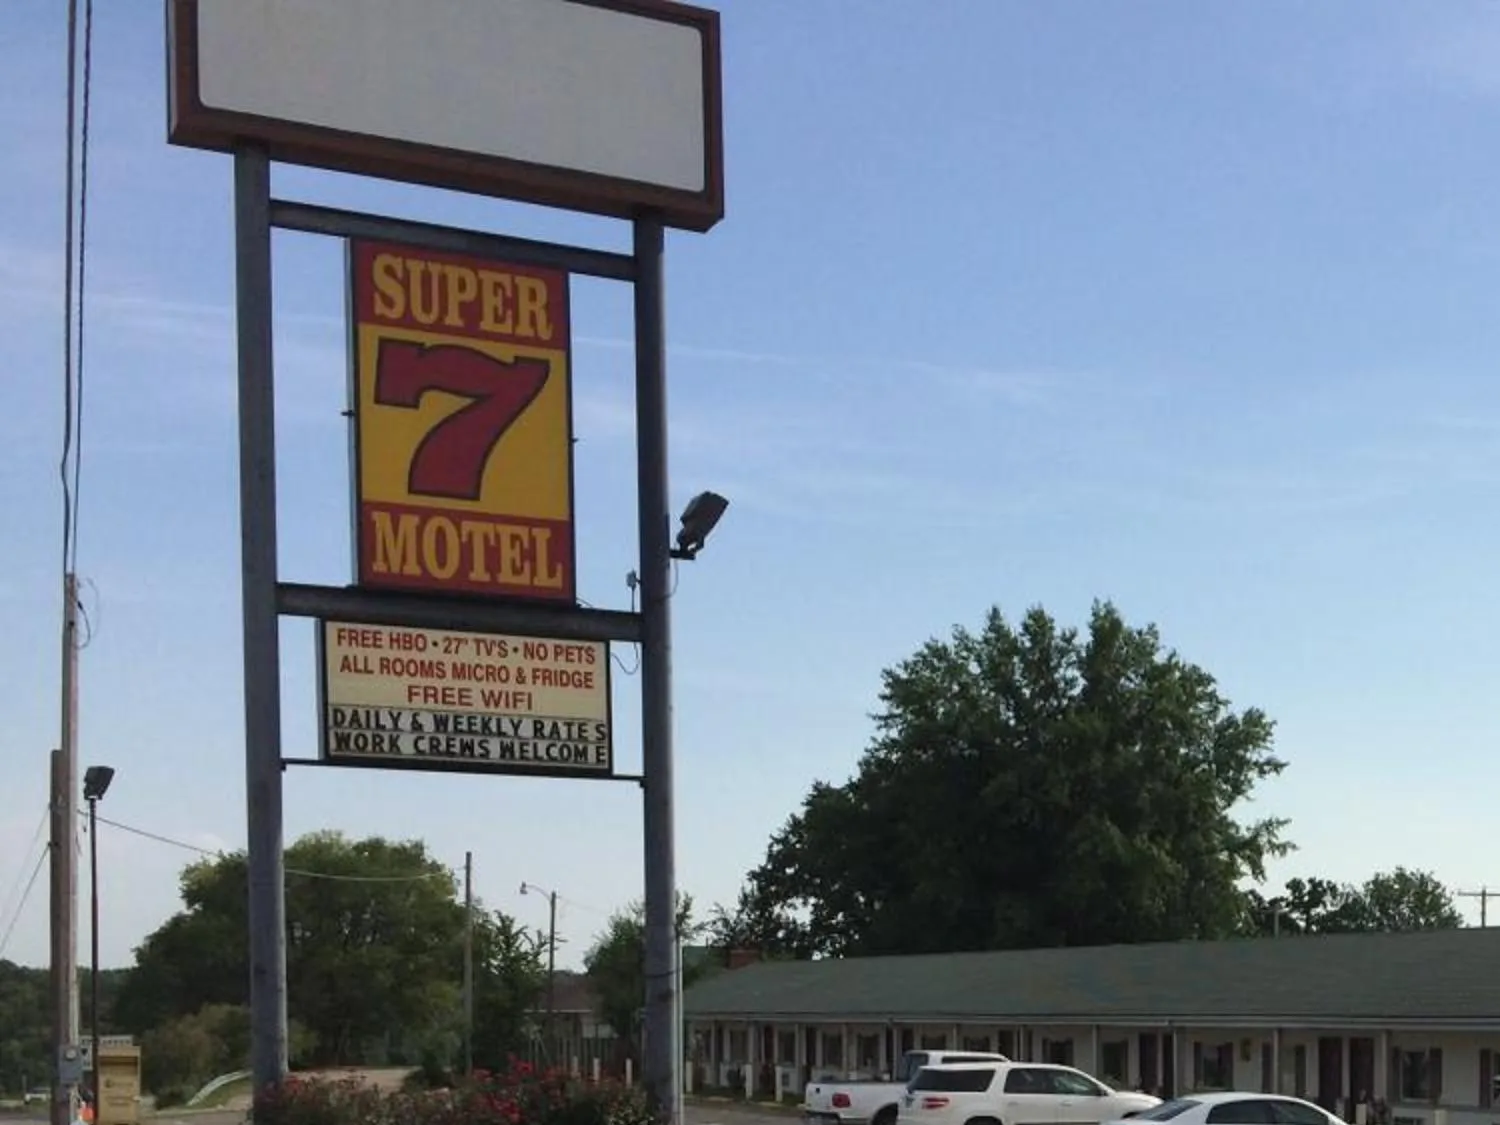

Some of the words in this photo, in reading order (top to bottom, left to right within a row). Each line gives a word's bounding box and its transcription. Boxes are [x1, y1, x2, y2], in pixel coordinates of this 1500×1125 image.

[372, 253, 553, 340] SUPER
[374, 336, 550, 501] 7
[371, 510, 564, 590] MOTEL
[336, 627, 383, 649] FREE
[389, 631, 427, 652] HBO
[523, 642, 549, 661] NO
[553, 644, 596, 665] PETS
[339, 655, 375, 675] ALL
[379, 657, 447, 680] ROOMS
[451, 663, 511, 683] MICRO
[515, 667, 527, 685] &
[531, 668, 595, 690] FRIDGE
[407, 684, 473, 707] FREE
[480, 689, 534, 711] WIFI
[332, 707, 403, 731] DAILY
[410, 711, 424, 731] &
[432, 713, 523, 738] WEEKLY
[535, 719, 607, 742] RATES
[334, 732, 402, 753] WORK
[413, 735, 491, 759] CREWS
[499, 741, 608, 764] WELCOME
